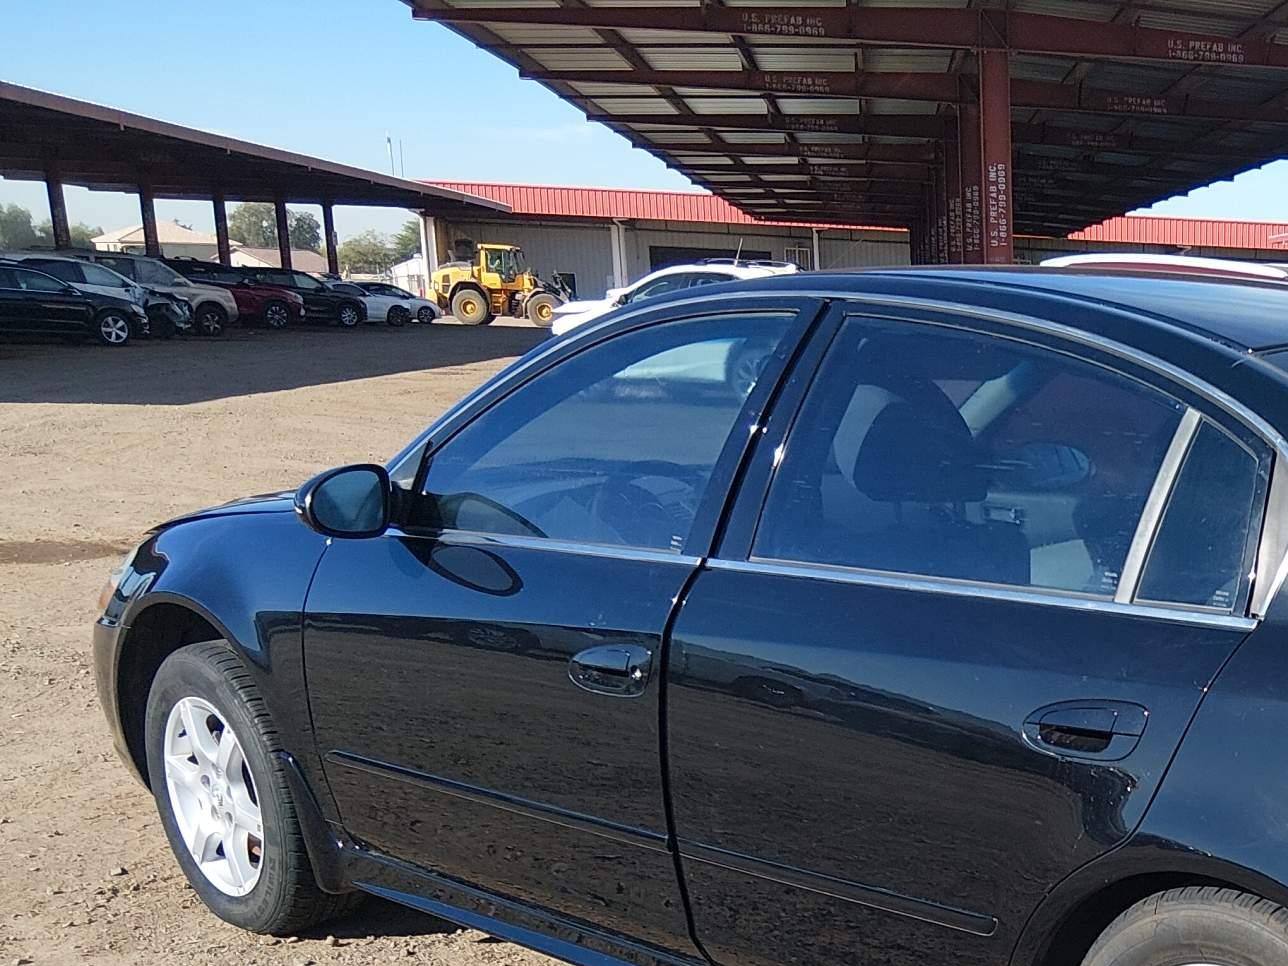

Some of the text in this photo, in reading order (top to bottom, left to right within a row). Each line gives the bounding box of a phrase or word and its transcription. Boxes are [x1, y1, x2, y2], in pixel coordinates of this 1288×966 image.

[765, 14, 803, 25] PREFAB
[1167, 39, 1245, 53] U.S. PREFAB INC.
[988, 162, 998, 247] U.S. PREFAB INC.
[997, 163, 1007, 246] 1-866-799-0969
